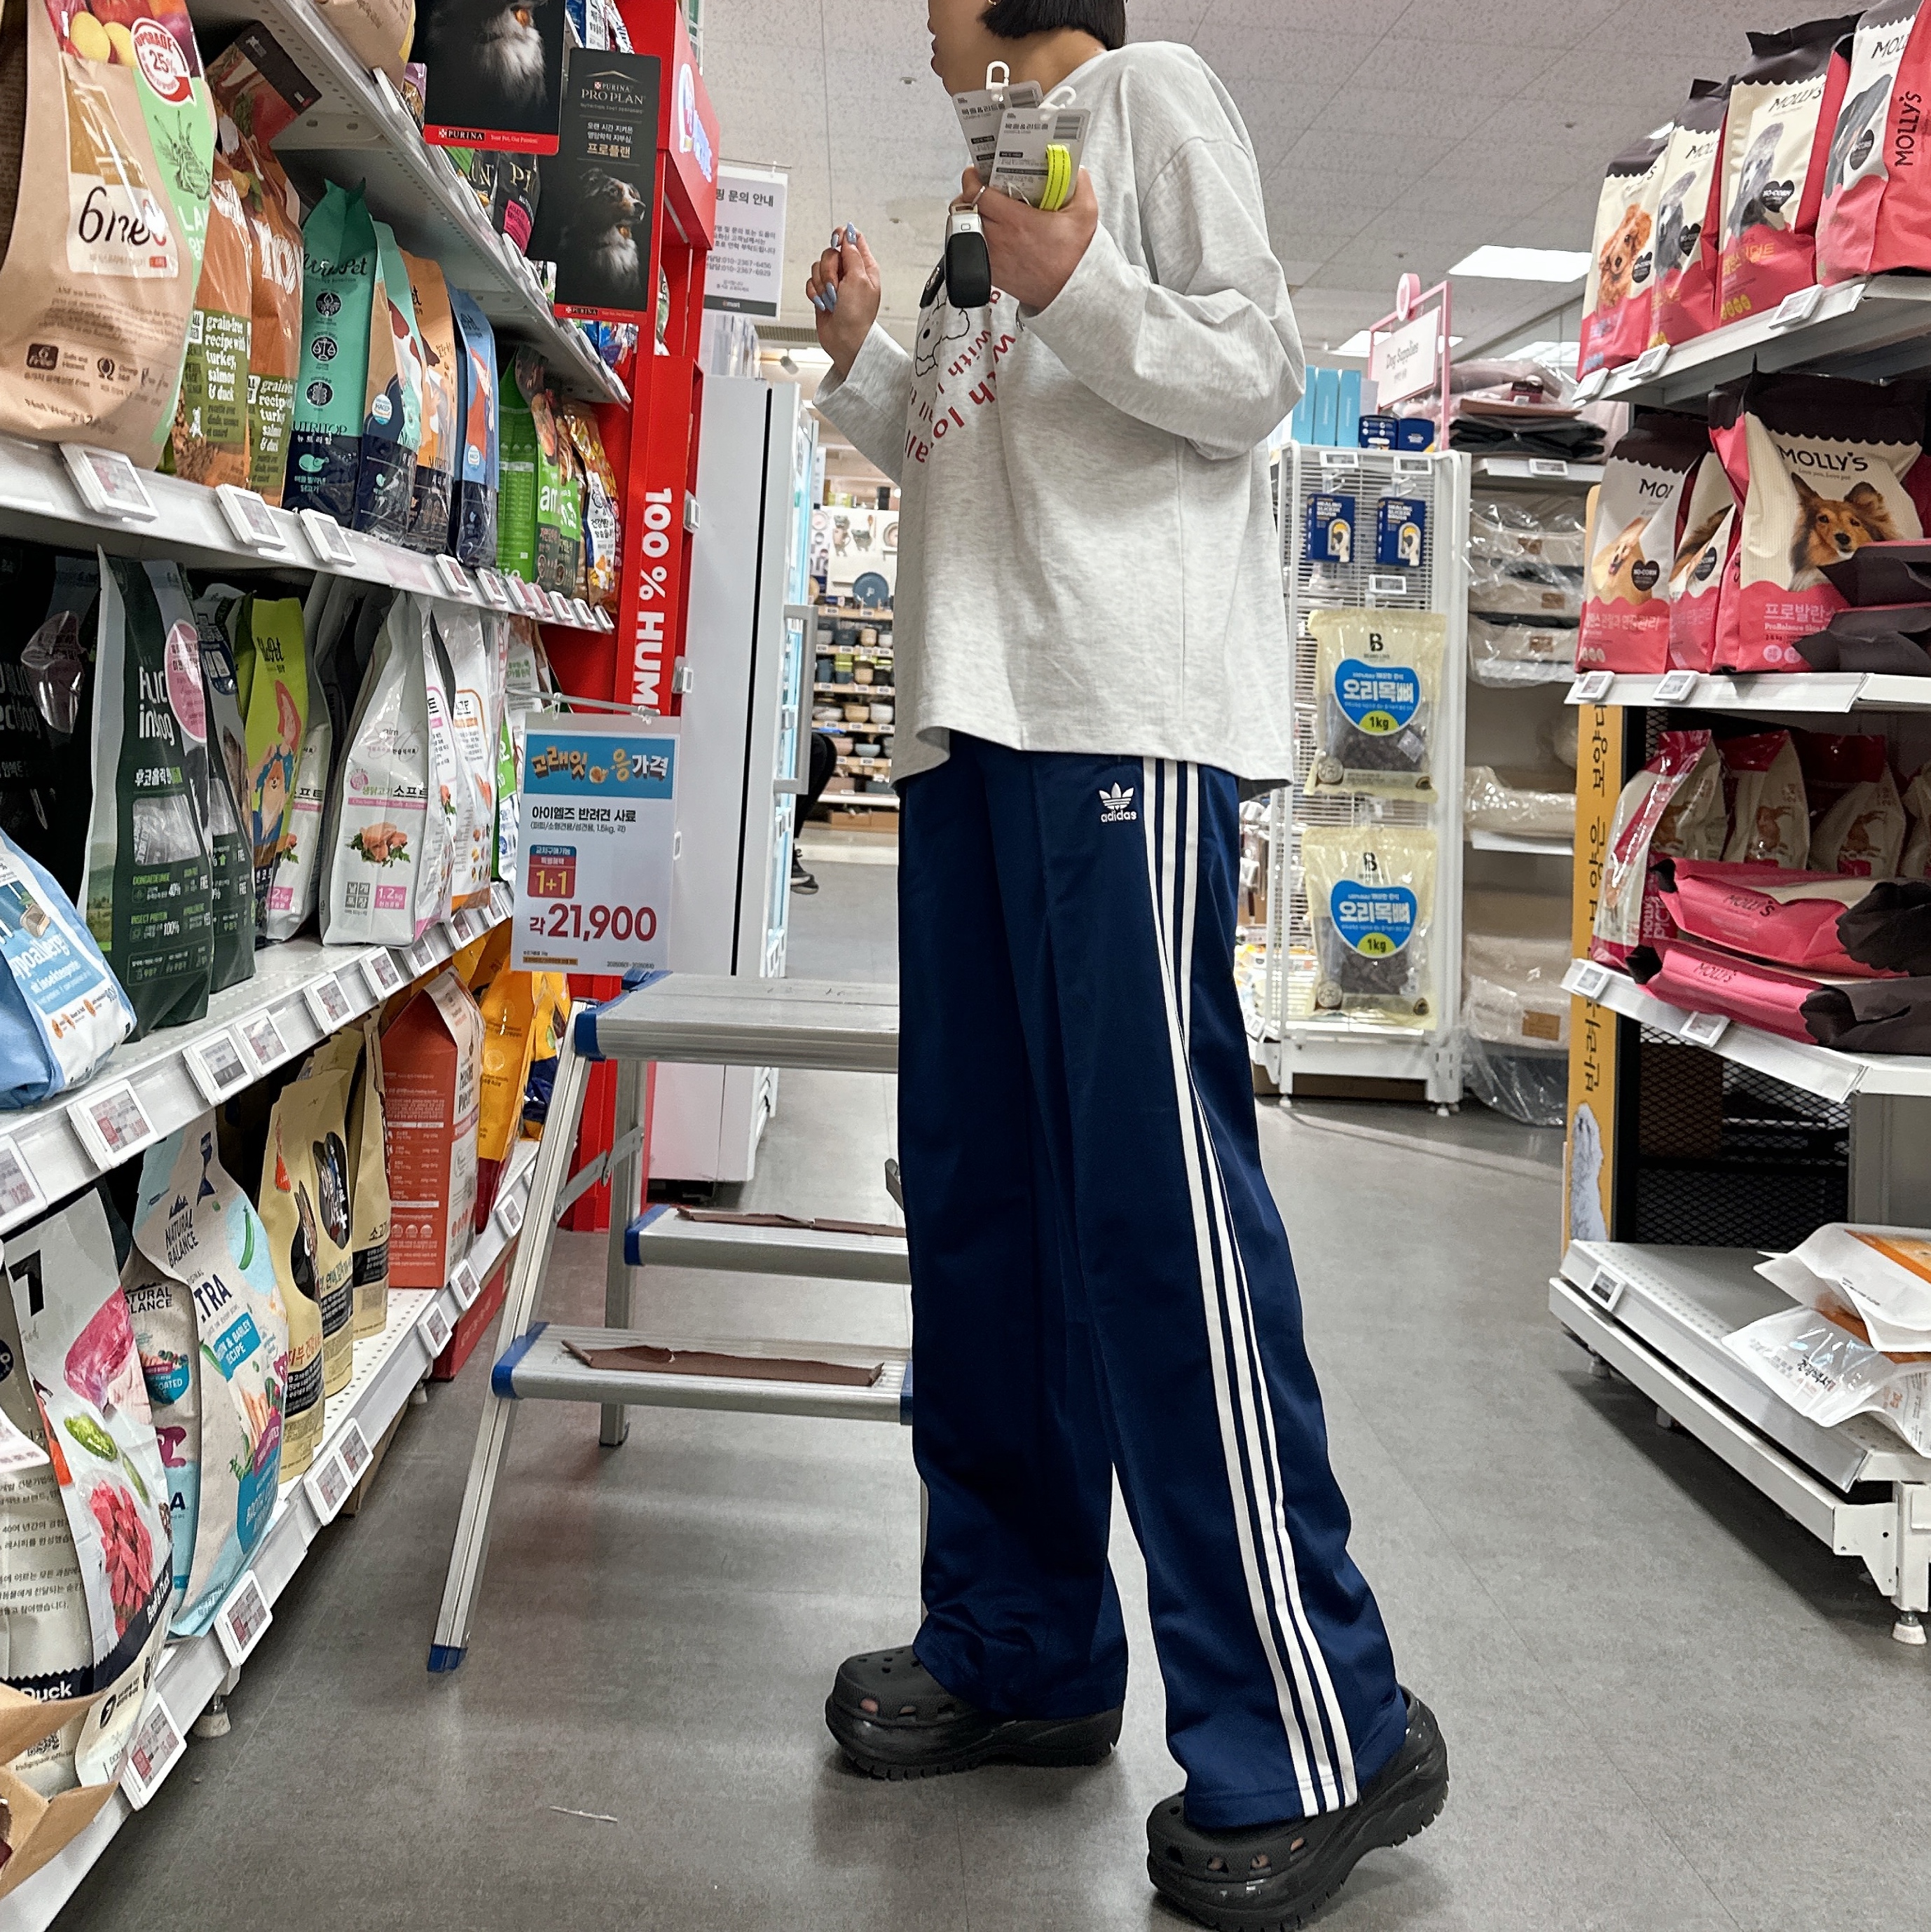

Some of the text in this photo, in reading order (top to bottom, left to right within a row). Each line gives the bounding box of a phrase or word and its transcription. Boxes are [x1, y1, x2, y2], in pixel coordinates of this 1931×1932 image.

[581, 88, 644, 105] PRO PLAN
[603, 83, 630, 93] PURINA
[448, 129, 483, 141] PURINA
[1895, 90, 1922, 167] MOLLY'S
[586, 142, 631, 159] 프로플랜
[729, 190, 749, 204] 문의
[753, 193, 774, 207] 안내
[205, 333, 233, 352] recipe
[205, 349, 237, 374] turkey,
[292, 420, 348, 435] UTRITOP
[1780, 445, 1869, 472] MOLLY'S
[640, 487, 673, 559] 100
[639, 568, 668, 601] %
[1342, 678, 1414, 704] 오리목뼈
[1369, 715, 1389, 731] 1kg
[578, 807, 610, 822] 반려견
[614, 809, 637, 823] 사료
[1101, 811, 1137, 823] adidas
[536, 870, 567, 895] 1+1
[378, 887, 404, 901] 1.2kg
[1339, 900, 1411, 924] 오리목뼈
[530, 903, 657, 943] 각 21,900
[1367, 938, 1387, 953] 1kg
[165, 1208, 194, 1251] NATURAL
[167, 1231, 199, 1268] BALANCE
[124, 1286, 172, 1303] ATURAL
[193, 1273, 232, 1324] TRA
[130, 1299, 173, 1314] LANCE
[226, 1341, 247, 1367] ECIPE
